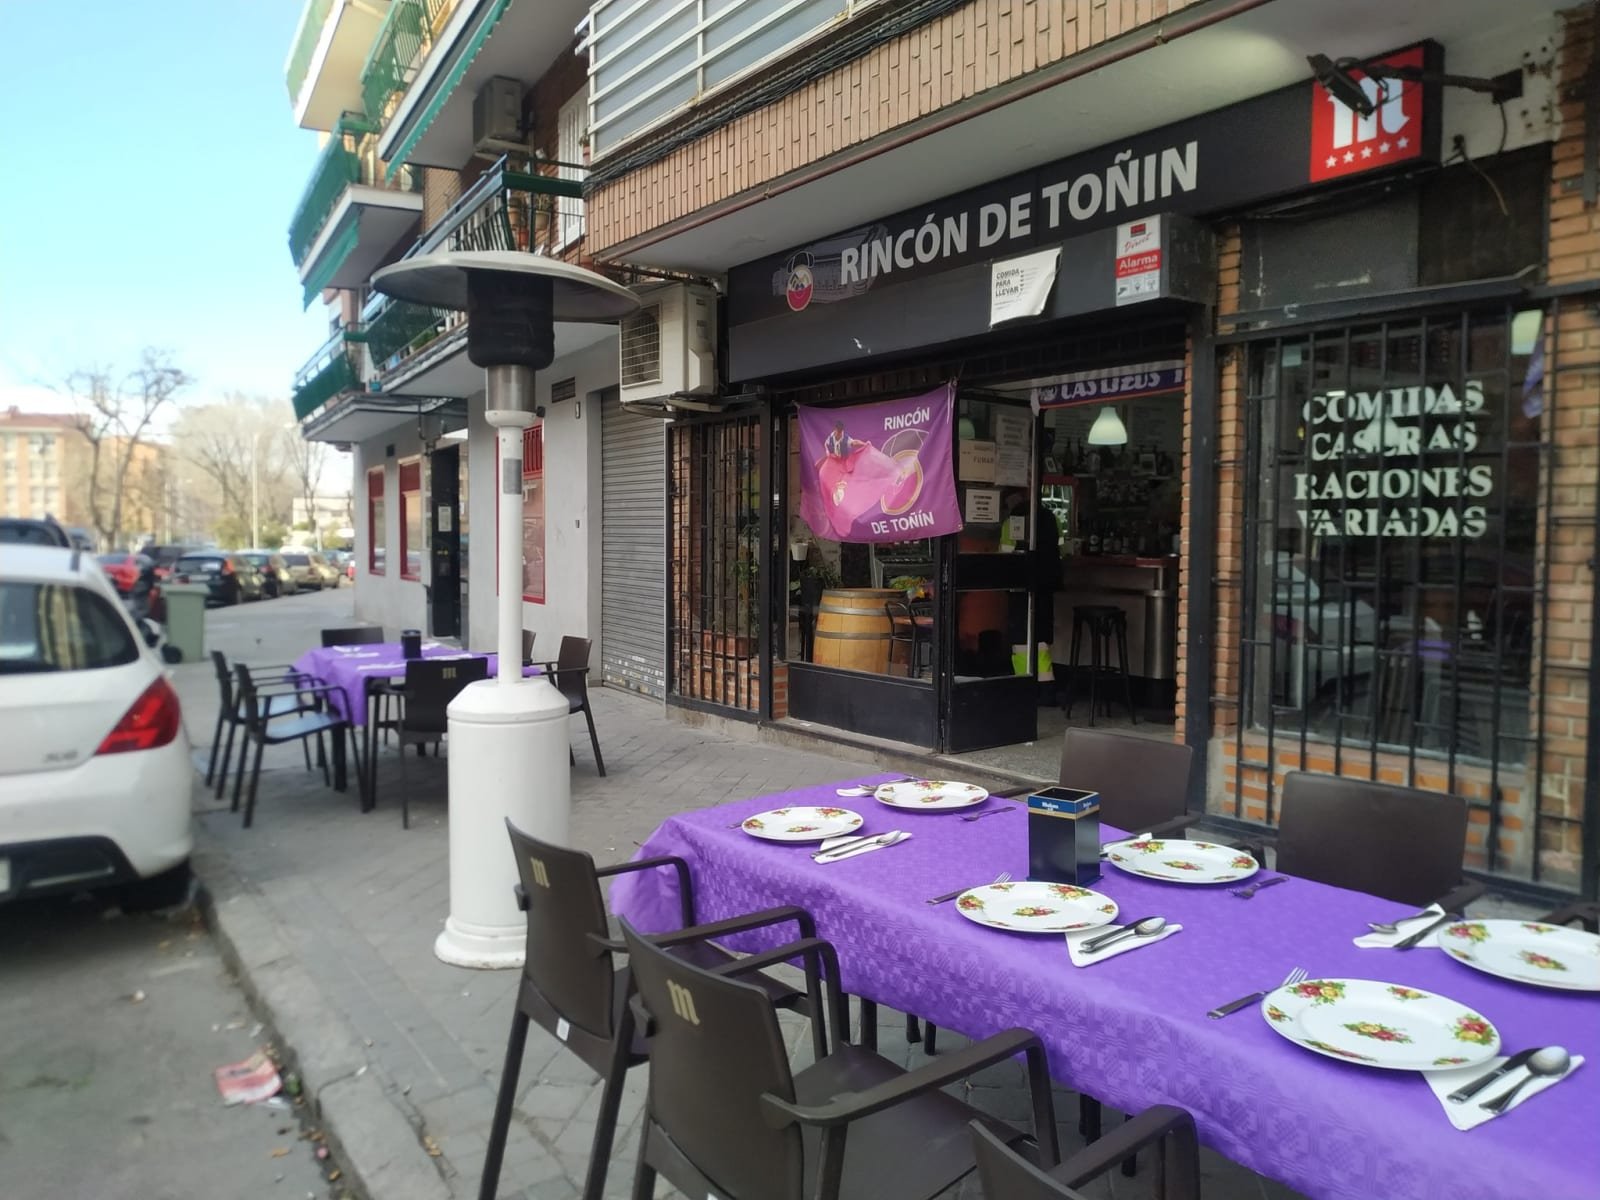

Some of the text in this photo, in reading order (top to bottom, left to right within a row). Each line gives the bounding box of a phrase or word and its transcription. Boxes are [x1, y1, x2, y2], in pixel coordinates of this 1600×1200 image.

[841, 141, 1198, 285] RINCÓN DE TOÑIN
[996, 268, 1020, 280] COMIDA
[1119, 254, 1158, 270] Alarma
[996, 279, 1011, 288] PARA
[996, 286, 1019, 297] LLEVAR
[1303, 380, 1484, 424] COMIDAS
[884, 407, 930, 431] RINCÓN
[1294, 465, 1493, 500] RACIONES
[871, 509, 935, 534] DE TOÑÍN
[1297, 506, 1487, 538] VARIADAS
